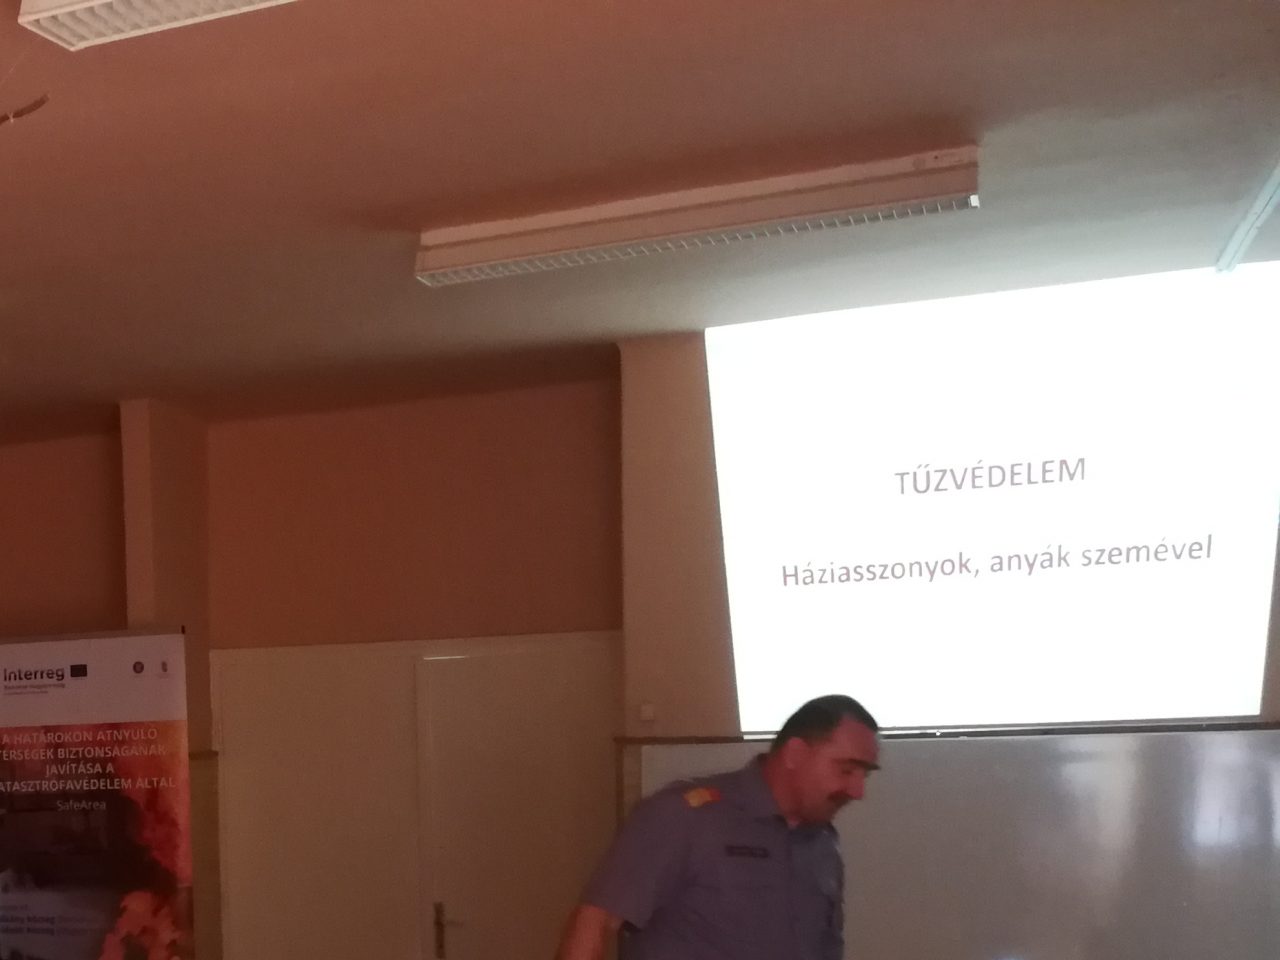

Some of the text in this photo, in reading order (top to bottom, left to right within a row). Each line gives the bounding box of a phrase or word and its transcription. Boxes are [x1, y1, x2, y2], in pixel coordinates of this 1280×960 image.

[894, 457, 1087, 496] TŰZVÉDELEM
[781, 534, 1215, 588] Háziasszonyok, anyák szemével
[3, 666, 65, 682] Interreg
[106, 763, 115, 774] A
